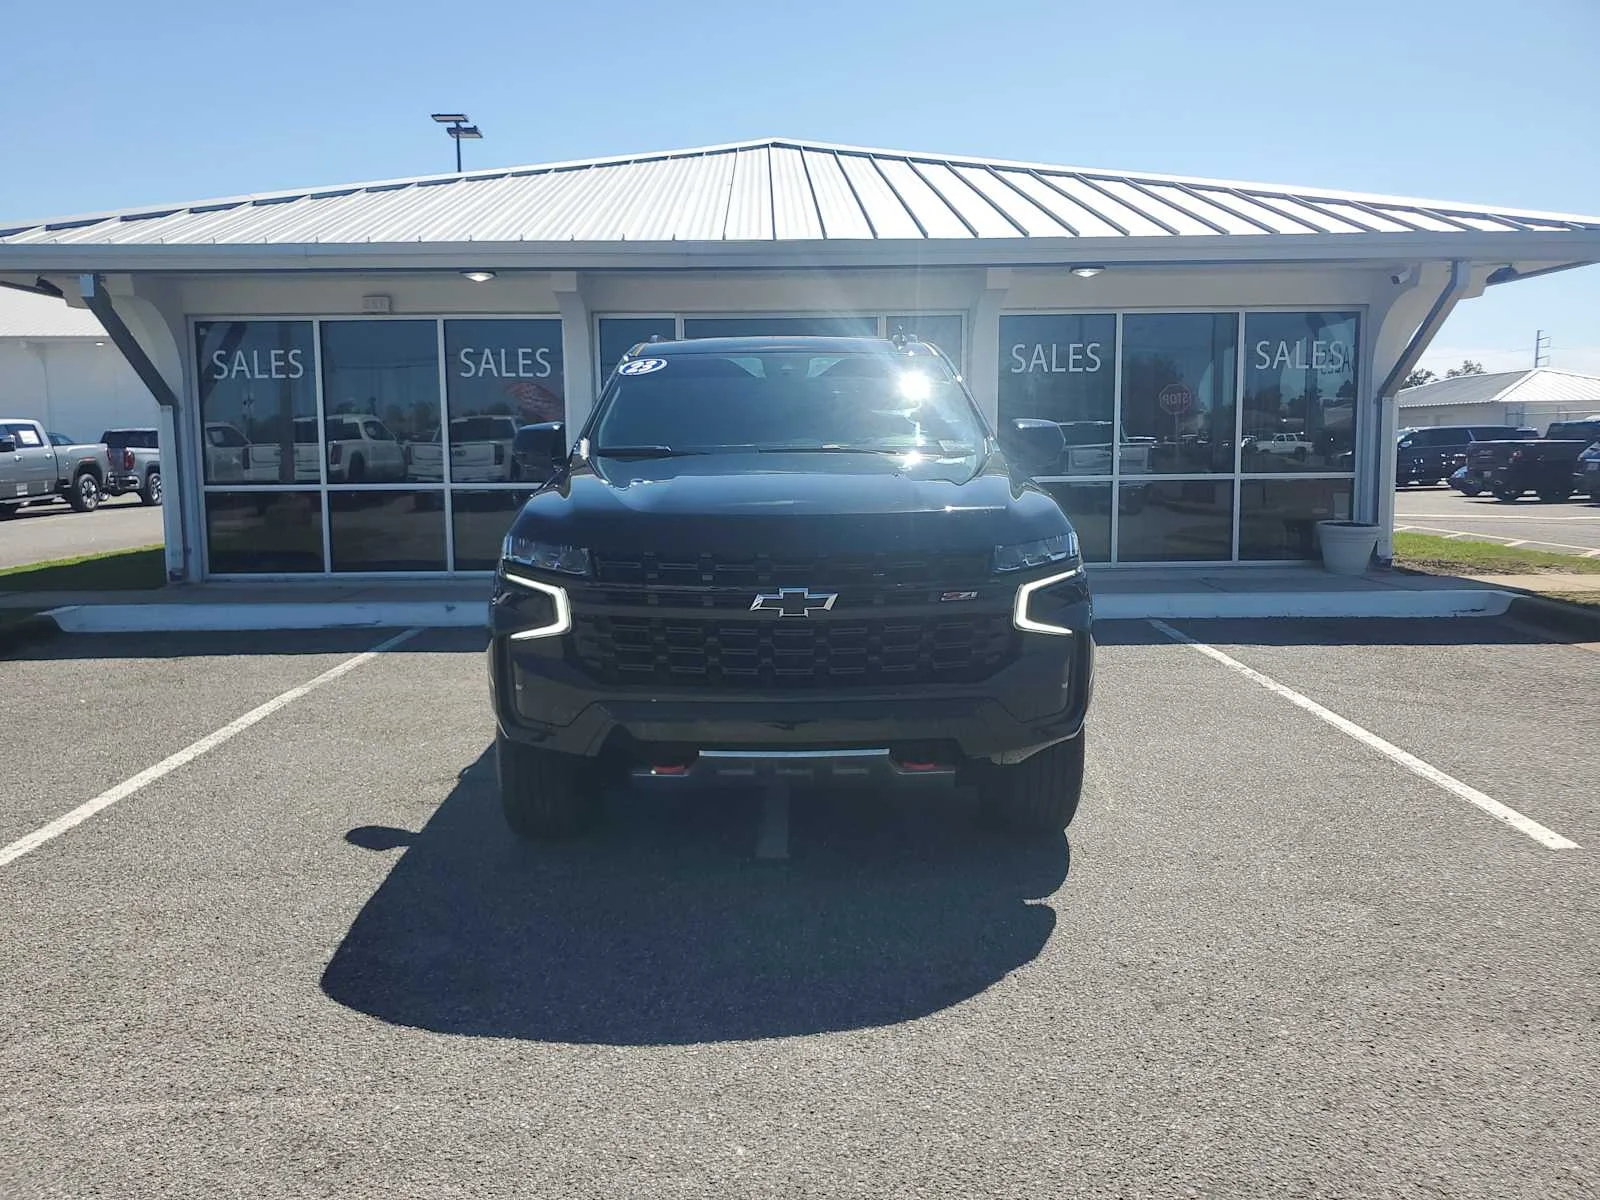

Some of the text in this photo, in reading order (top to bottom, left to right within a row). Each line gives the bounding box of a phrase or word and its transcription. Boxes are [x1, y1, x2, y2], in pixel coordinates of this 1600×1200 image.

[212, 349, 304, 379] SALES
[460, 347, 551, 378] SALES
[1011, 343, 1101, 373] SALES
[1255, 340, 1344, 370] SALES
